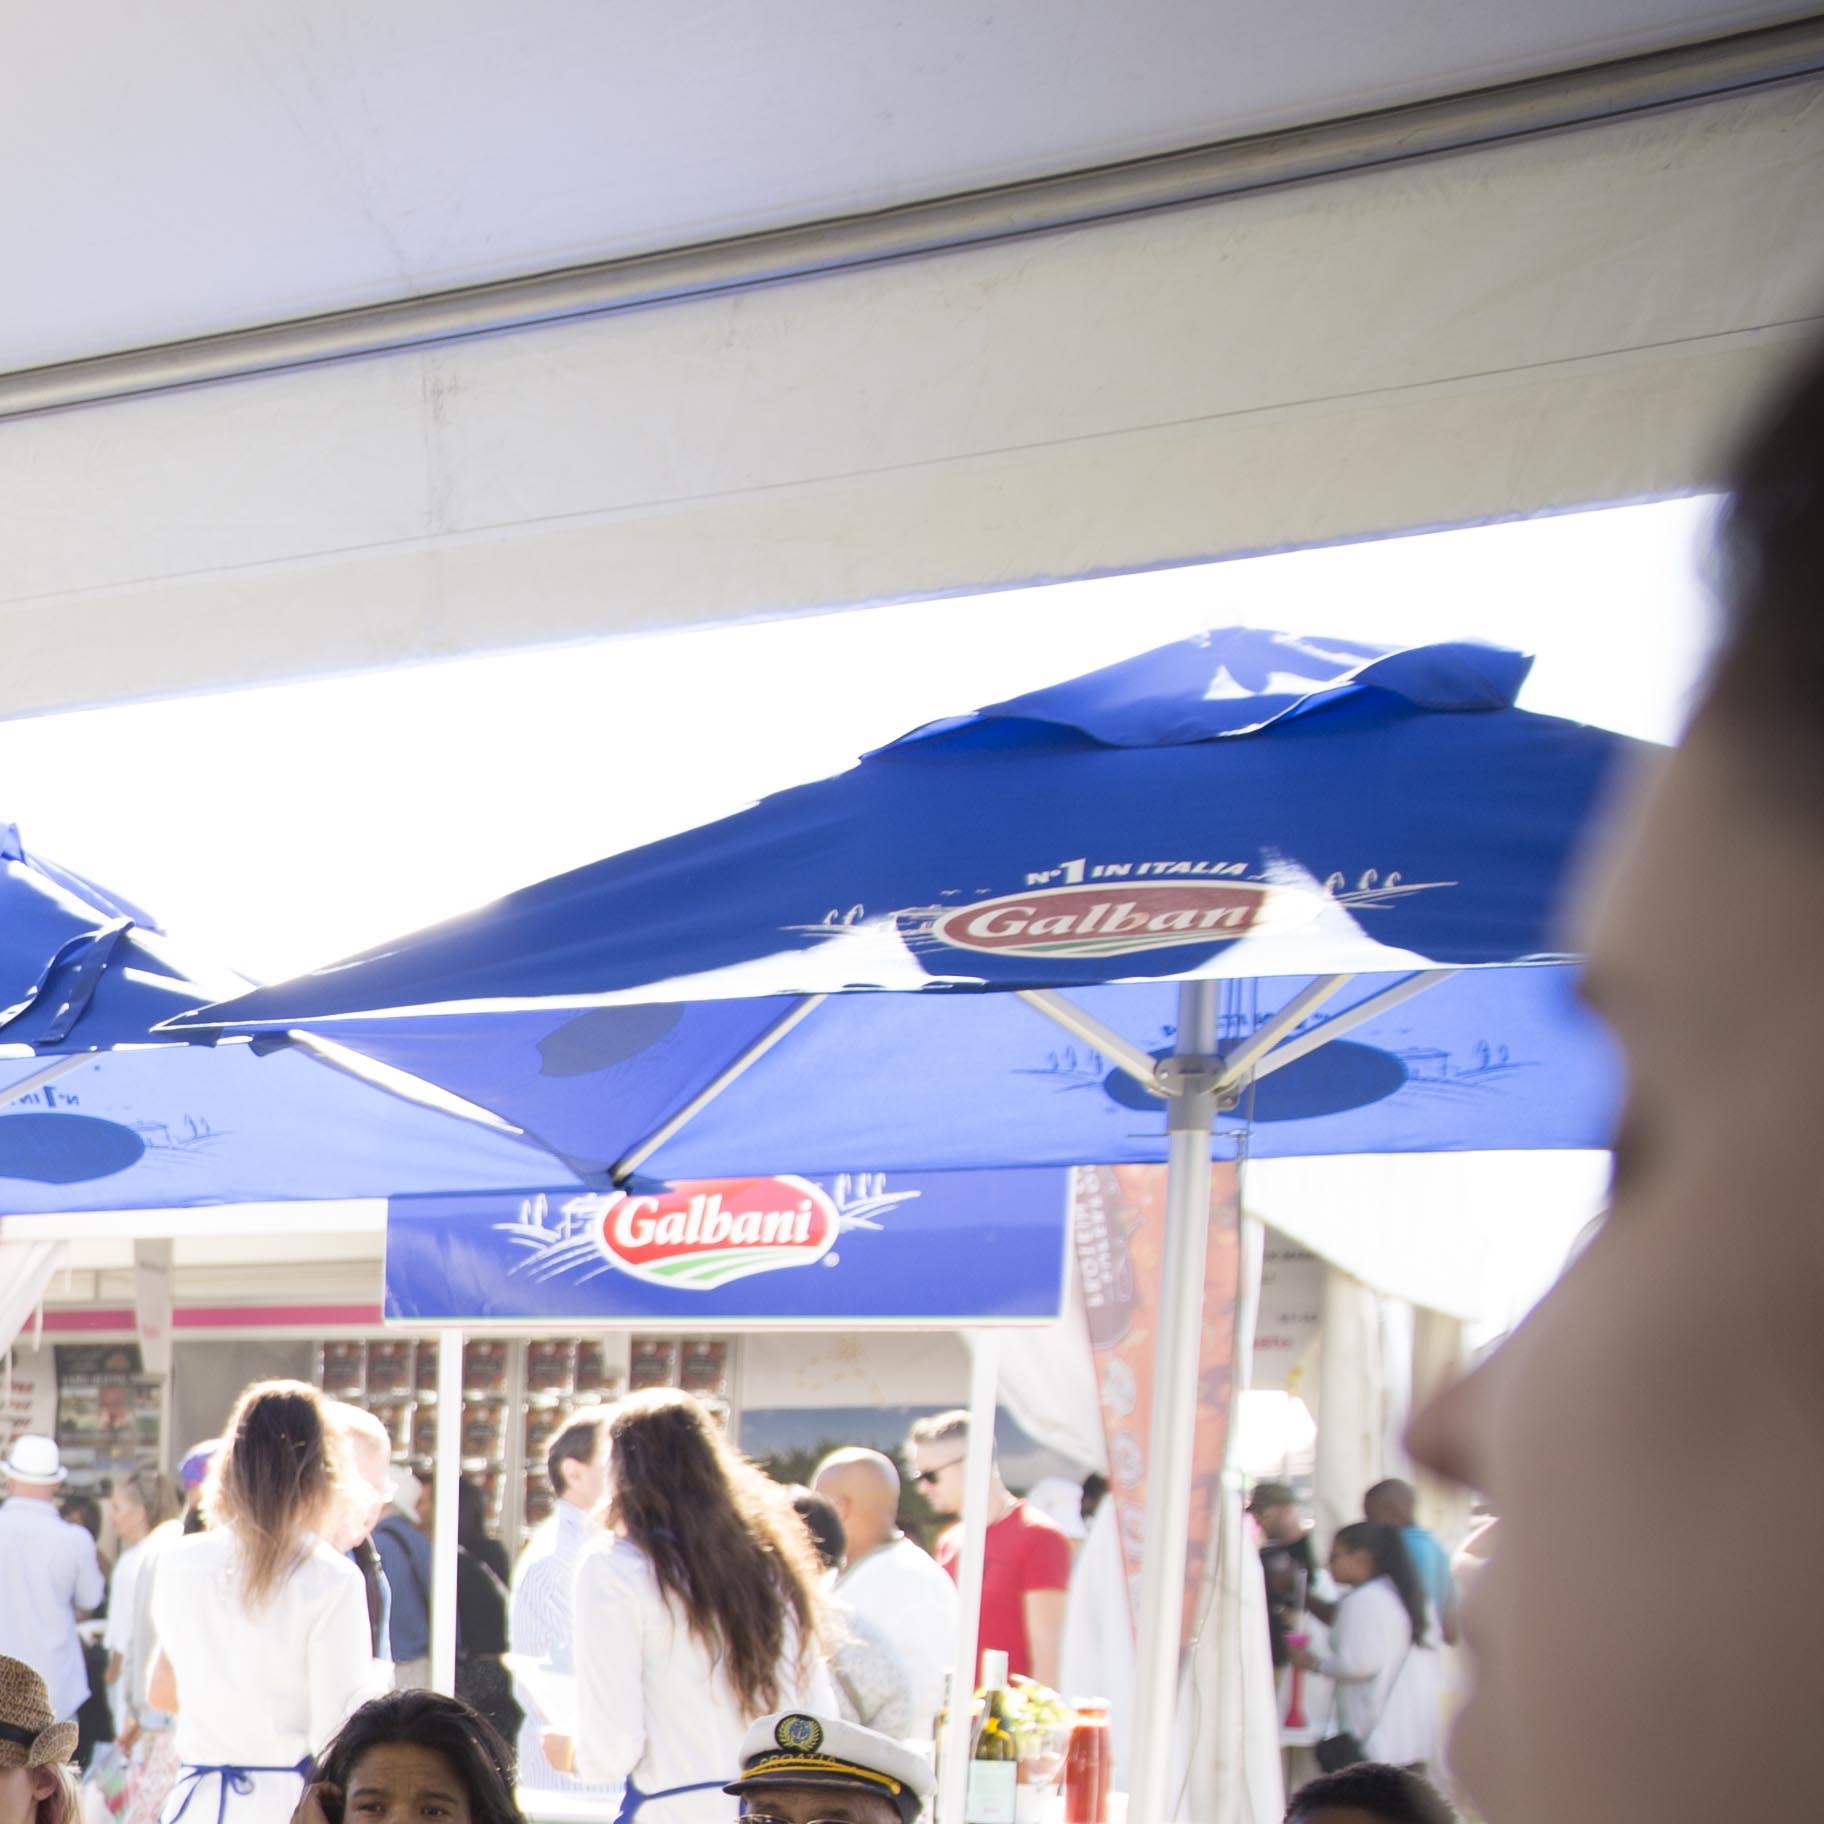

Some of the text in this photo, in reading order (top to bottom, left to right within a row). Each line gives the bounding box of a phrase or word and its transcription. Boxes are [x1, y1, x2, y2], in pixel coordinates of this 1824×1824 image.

[1091, 863, 1131, 879] IN
[1134, 860, 1249, 876] ITALIA
[967, 901, 1260, 939] Galban
[613, 1193, 815, 1249] Galbani
